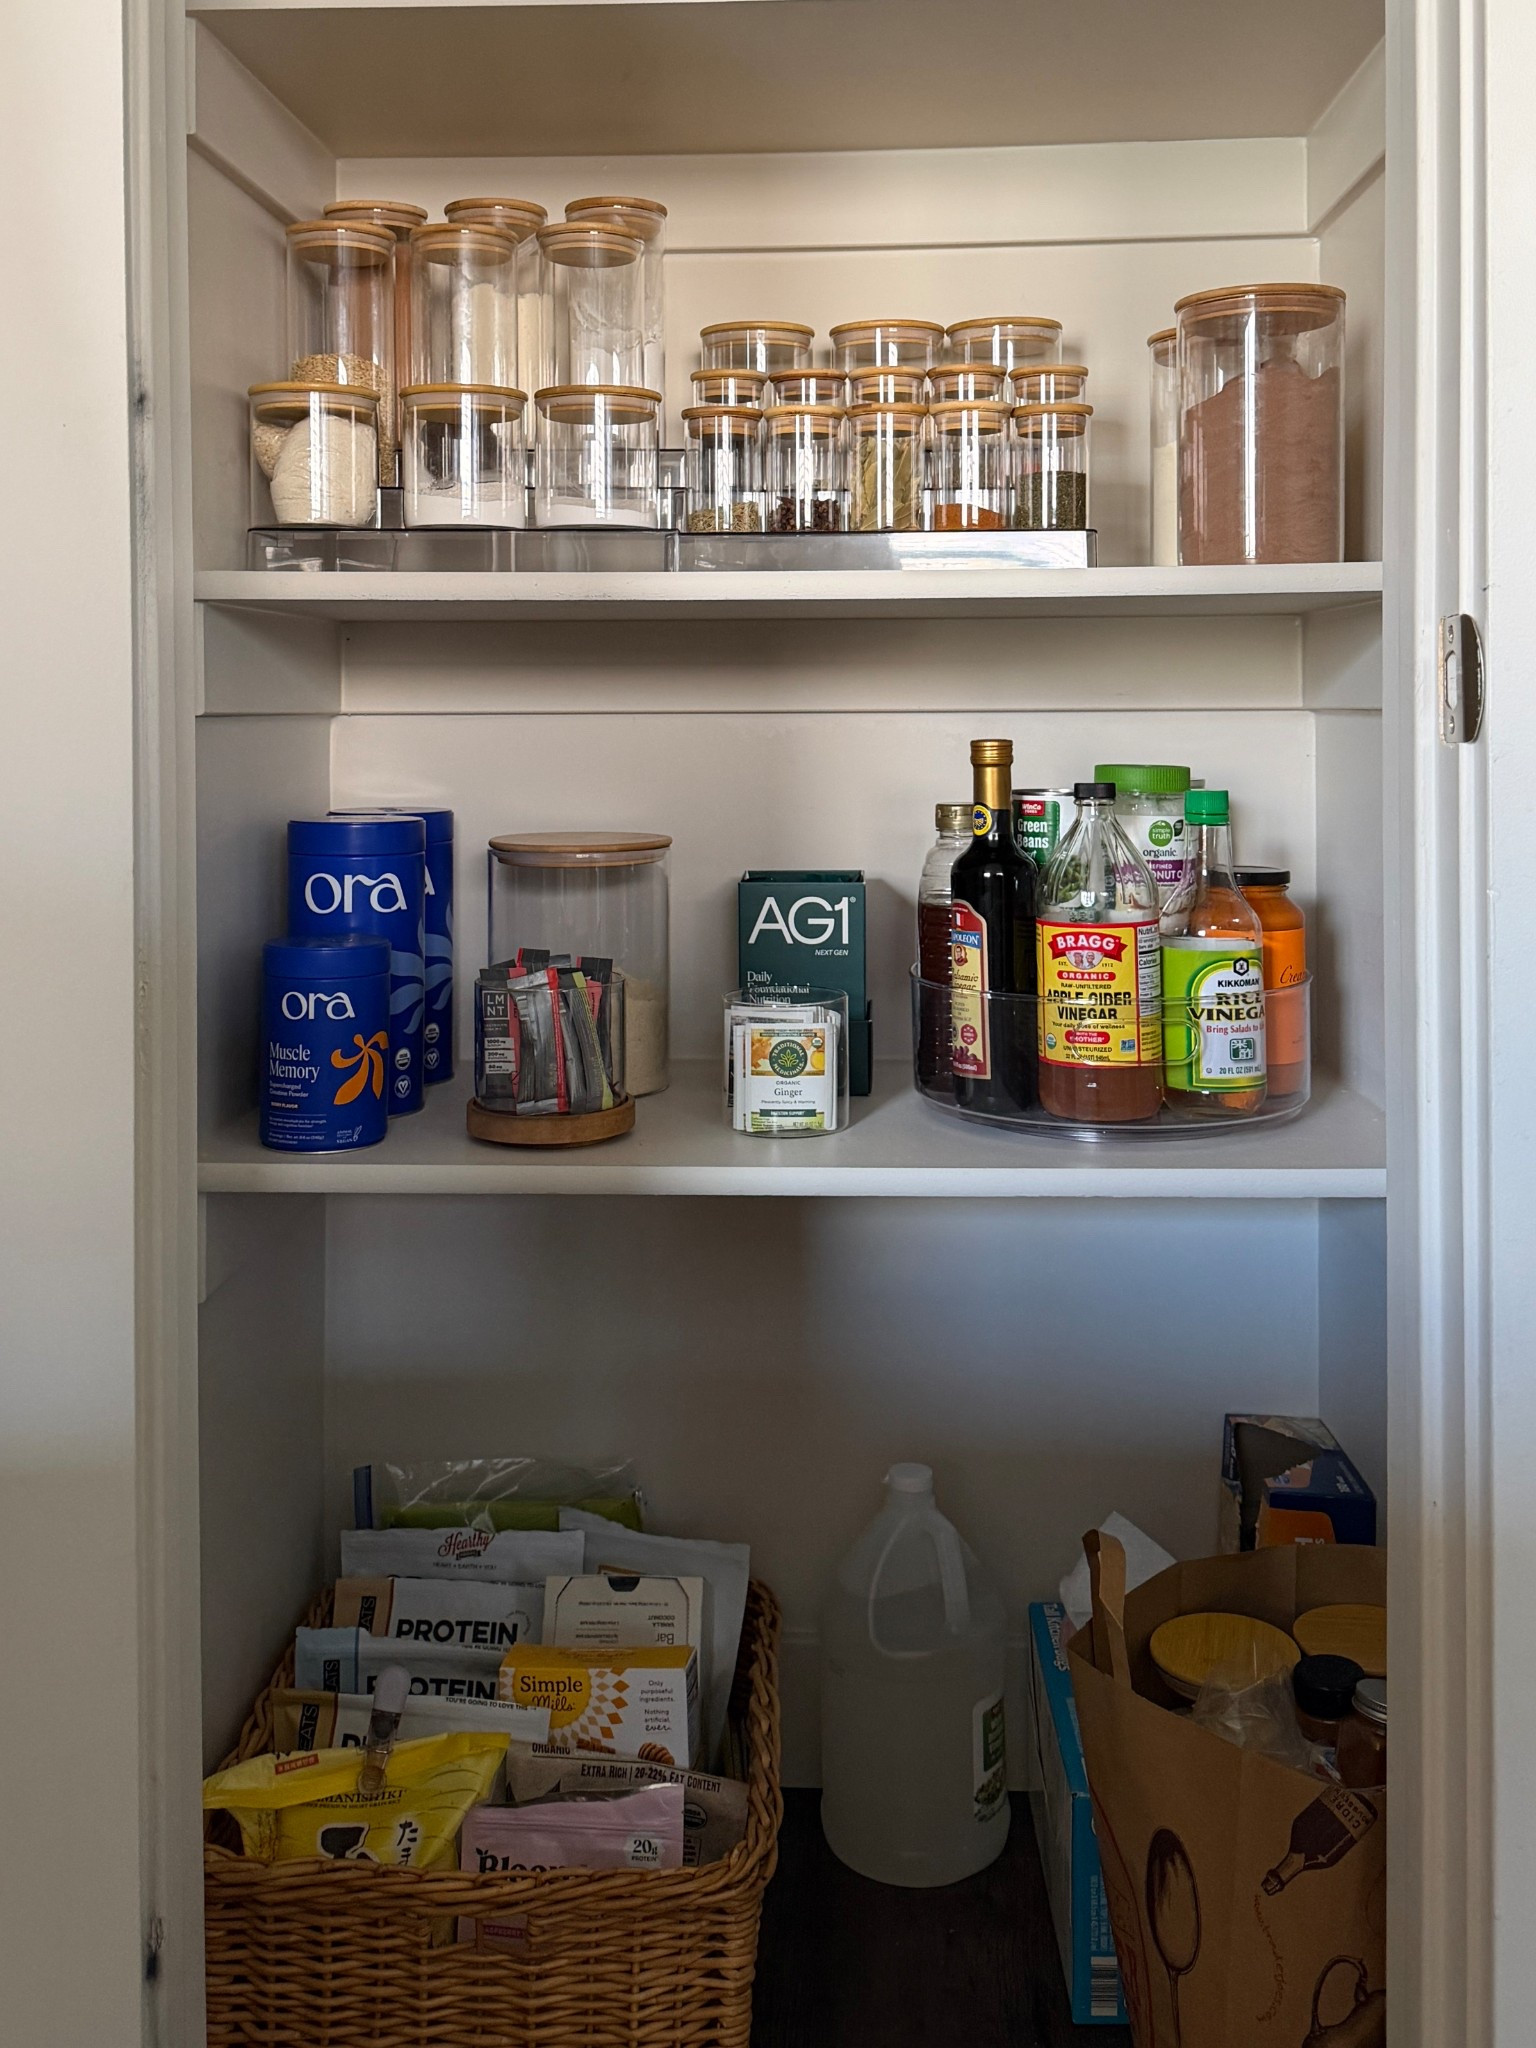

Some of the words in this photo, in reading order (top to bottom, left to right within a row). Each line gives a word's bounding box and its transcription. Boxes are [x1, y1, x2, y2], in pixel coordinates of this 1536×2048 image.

[1018, 818, 1048, 833] Green
[1016, 834, 1049, 848] Beans
[1142, 848, 1177, 858] organic
[304, 872, 408, 915] ora
[747, 896, 849, 945] AG1
[1056, 934, 1116, 951] BRAGG
[747, 971, 772, 984] Daily
[1218, 978, 1260, 988] KIKKOMAN
[747, 982, 810, 994] Foundational
[749, 994, 791, 1005] Nutrition
[1047, 989, 1084, 1006] APPLE
[1088, 992, 1132, 1006] CIDER
[281, 991, 356, 1020] ora
[1058, 1006, 1118, 1020] VINEGAR
[1190, 1006, 1265, 1021] VINEGA
[1206, 1025, 1228, 1035] Bring
[1230, 1024, 1252, 1033] Salads
[269, 1041, 310, 1061] Muscle
[772, 1042, 805, 1057] TRADITIONAL
[269, 1062, 320, 1084] Memory
[774, 1088, 803, 1098] Ginger
[437, 1531, 495, 1557] Hearthy
[396, 1618, 518, 1646] PROTEIN
[655, 1633, 674, 1645] Bar
[366, 1675, 496, 1700] POTEIN
[520, 1676, 583, 1696] Simple
[648, 1680, 664, 1688] Only
[640, 1688, 674, 1696] purposeful
[531, 1695, 574, 1712] Mills
[640, 1696, 674, 1704] ingredients
[644, 1708, 670, 1716] Nothing
[532, 1742, 571, 1755] ORGANIC
[580, 1764, 606, 1778] EXTRA
[610, 1766, 628, 1779] RICH
[686, 1776, 721, 1794] CONTENT
[1329, 1794, 1362, 1830] CIDRE
